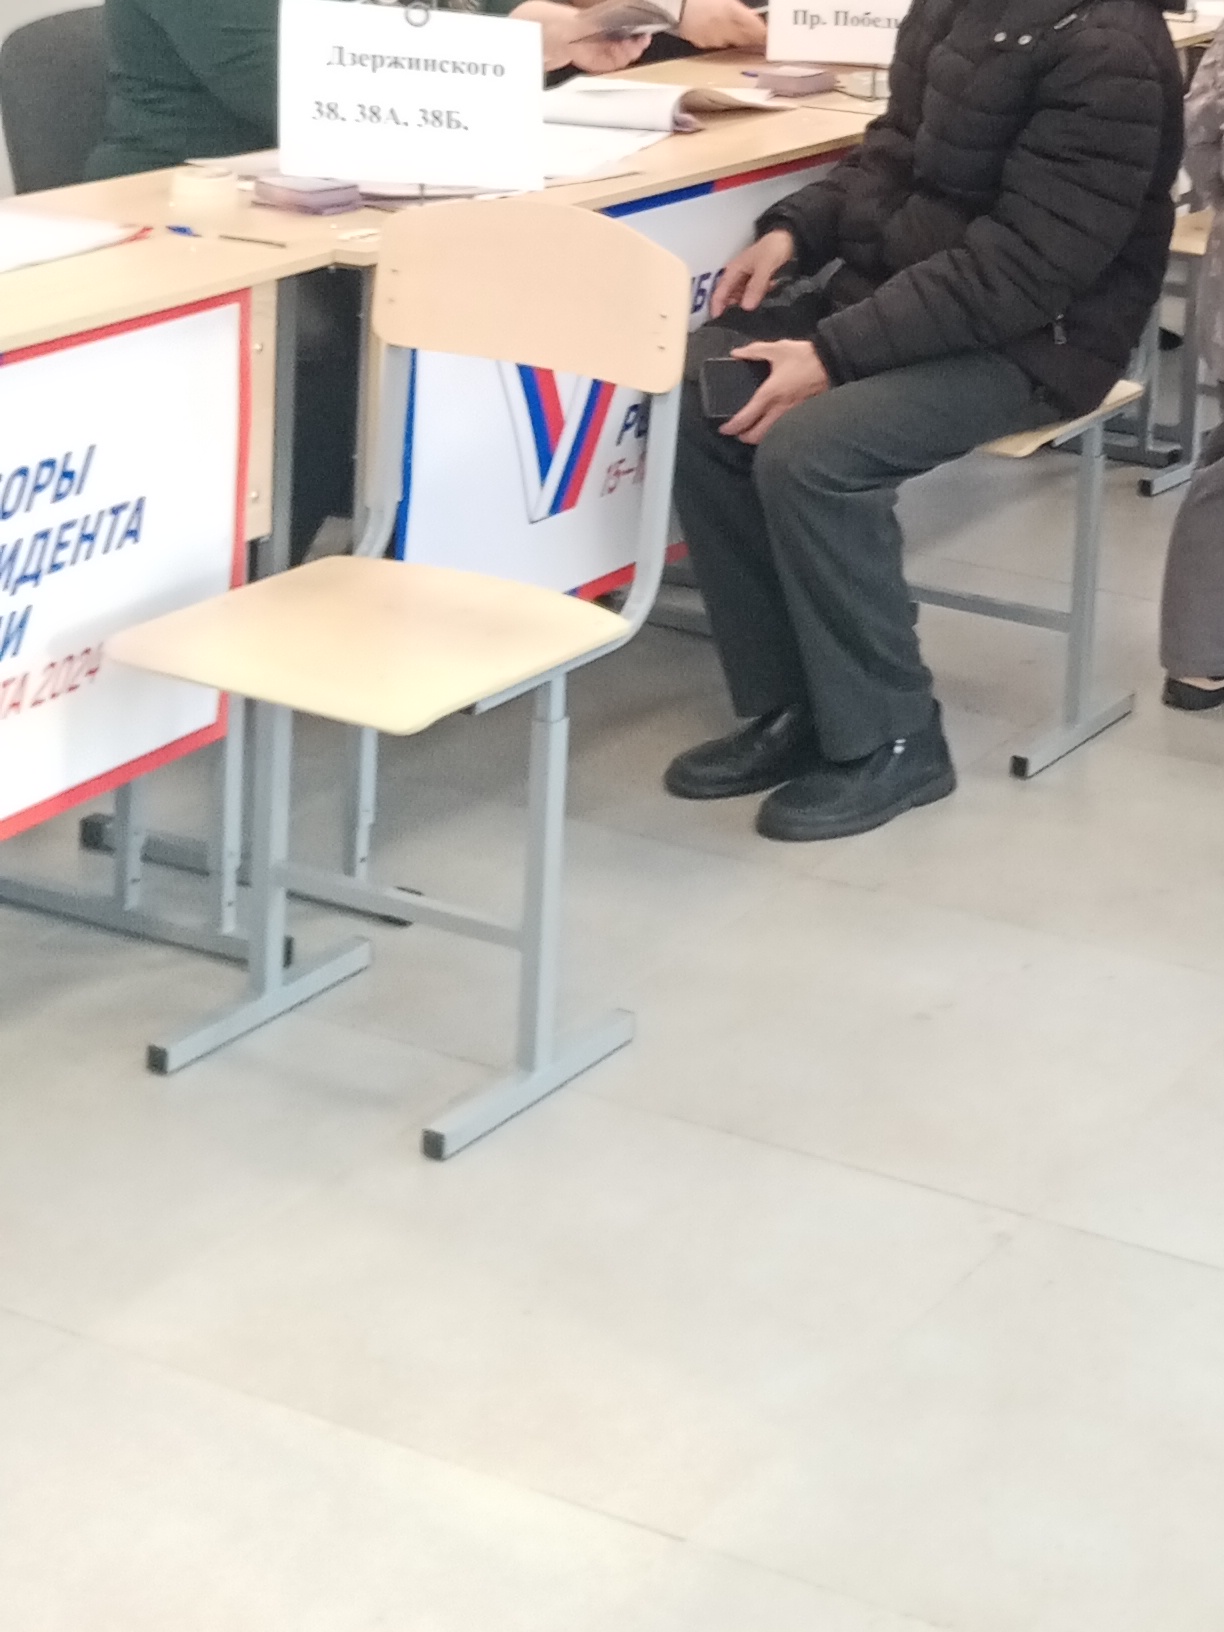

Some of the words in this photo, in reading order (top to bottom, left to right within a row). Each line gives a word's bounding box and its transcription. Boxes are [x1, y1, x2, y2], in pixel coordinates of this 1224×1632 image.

[793, 9, 828, 30] Пр.
[326, 45, 506, 77] Дзержинского
[0, 444, 97, 520] ОРЫ
